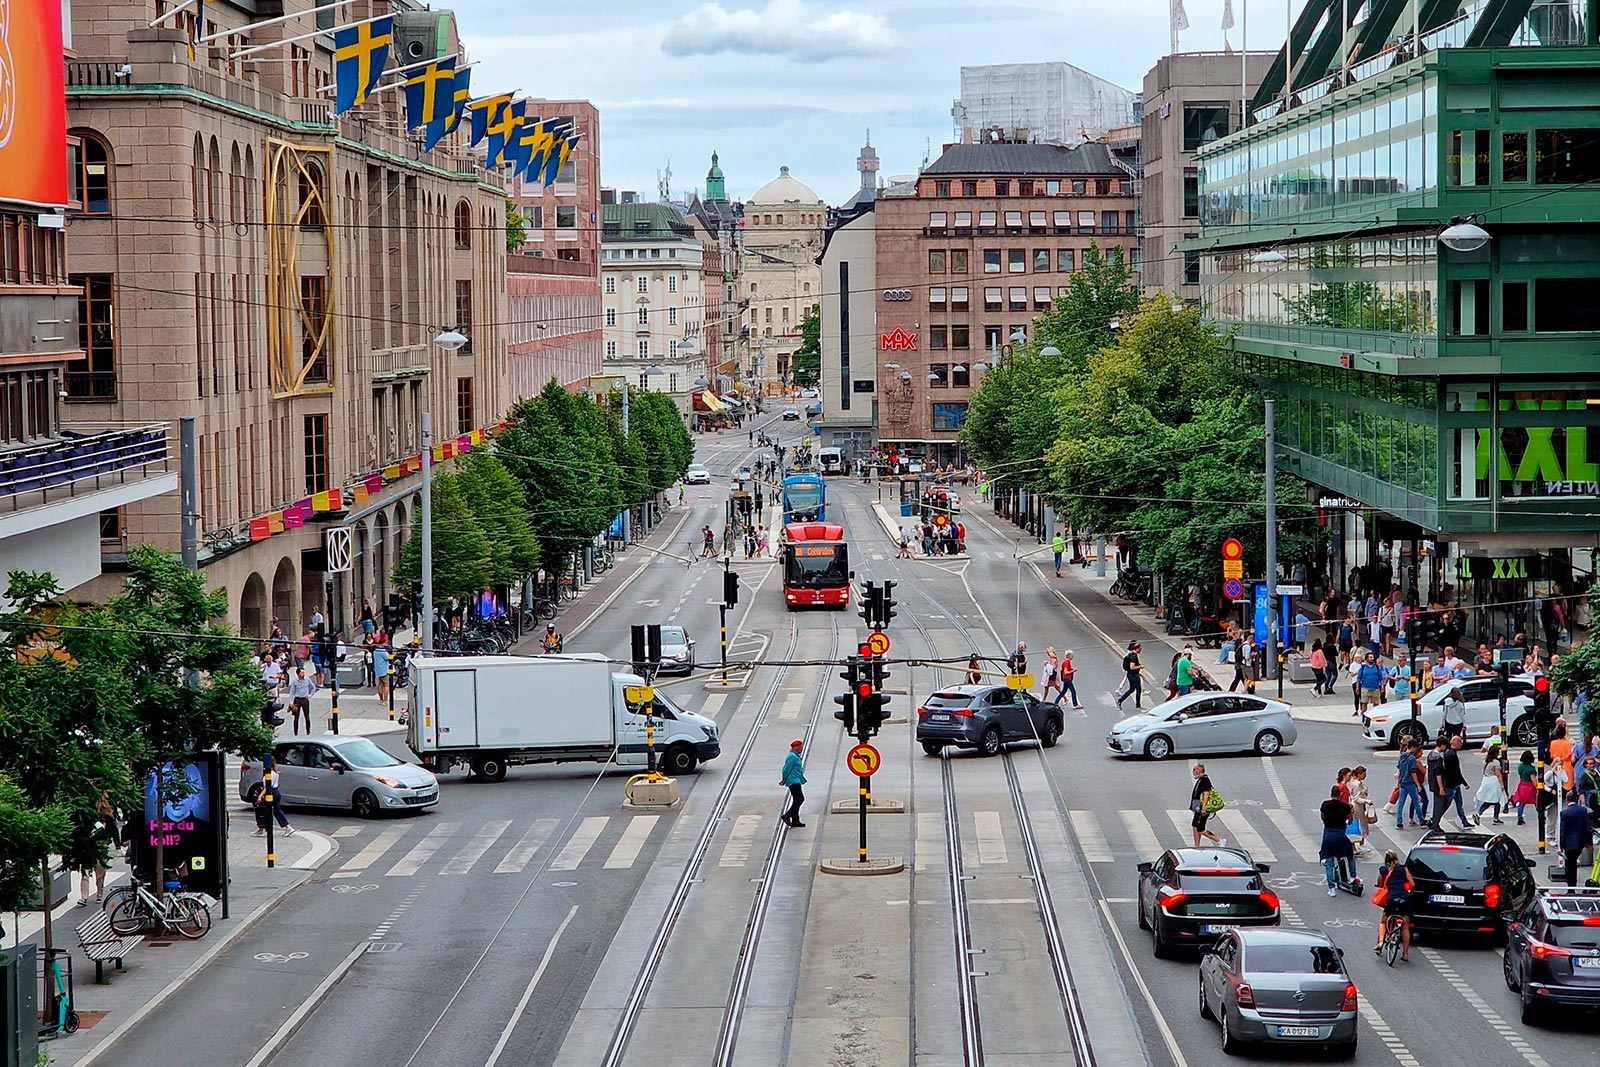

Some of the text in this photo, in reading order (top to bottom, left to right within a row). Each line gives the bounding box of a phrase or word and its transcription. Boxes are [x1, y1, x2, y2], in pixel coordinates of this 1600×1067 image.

[882, 327, 916, 350] MAX
[1475, 399, 1599, 481] XXL
[329, 529, 350, 571] NK
[1492, 558, 1528, 578] XXL
[150, 820, 194, 831] Har du
[1281, 1027, 1291, 1035] KA
